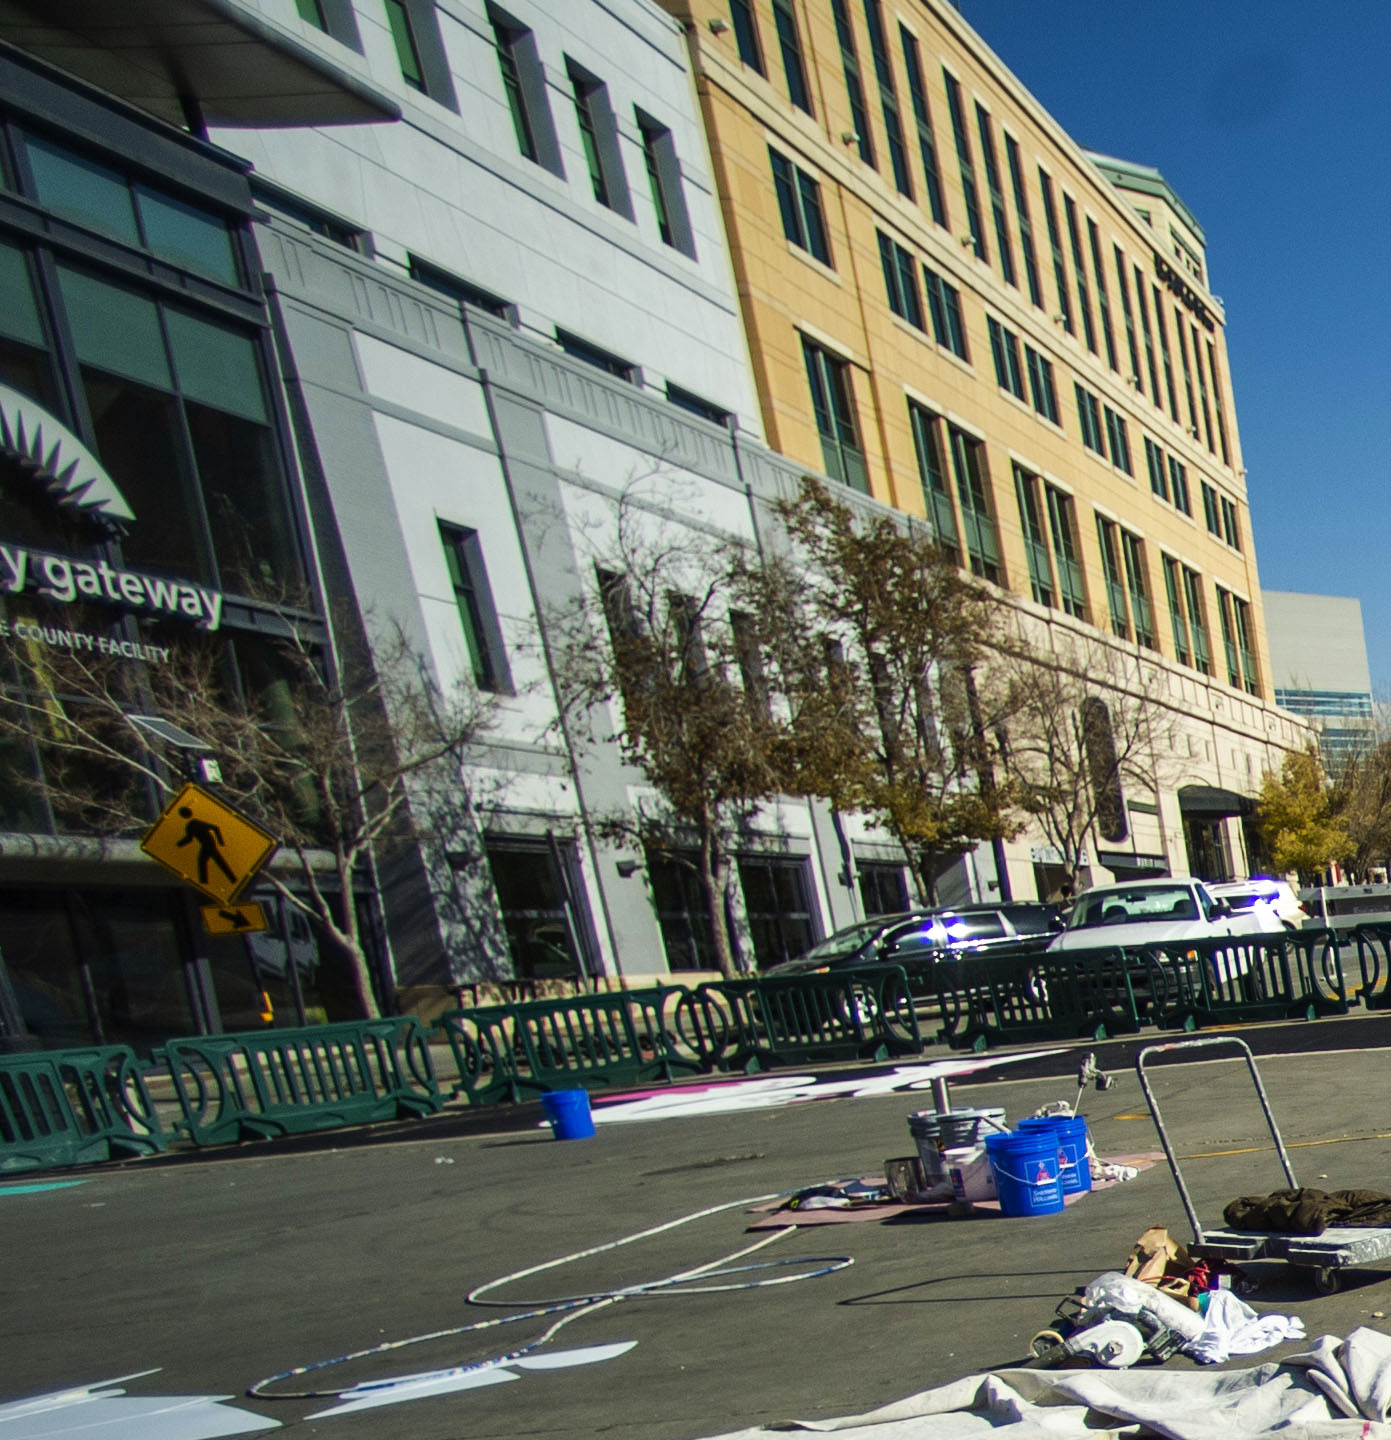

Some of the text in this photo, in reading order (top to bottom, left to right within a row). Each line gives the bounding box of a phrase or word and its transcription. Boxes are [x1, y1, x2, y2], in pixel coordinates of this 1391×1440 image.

[38, 556, 222, 631] gateway
[15, 622, 94, 651] COUNTY
[98, 636, 170, 664] FACILITY
